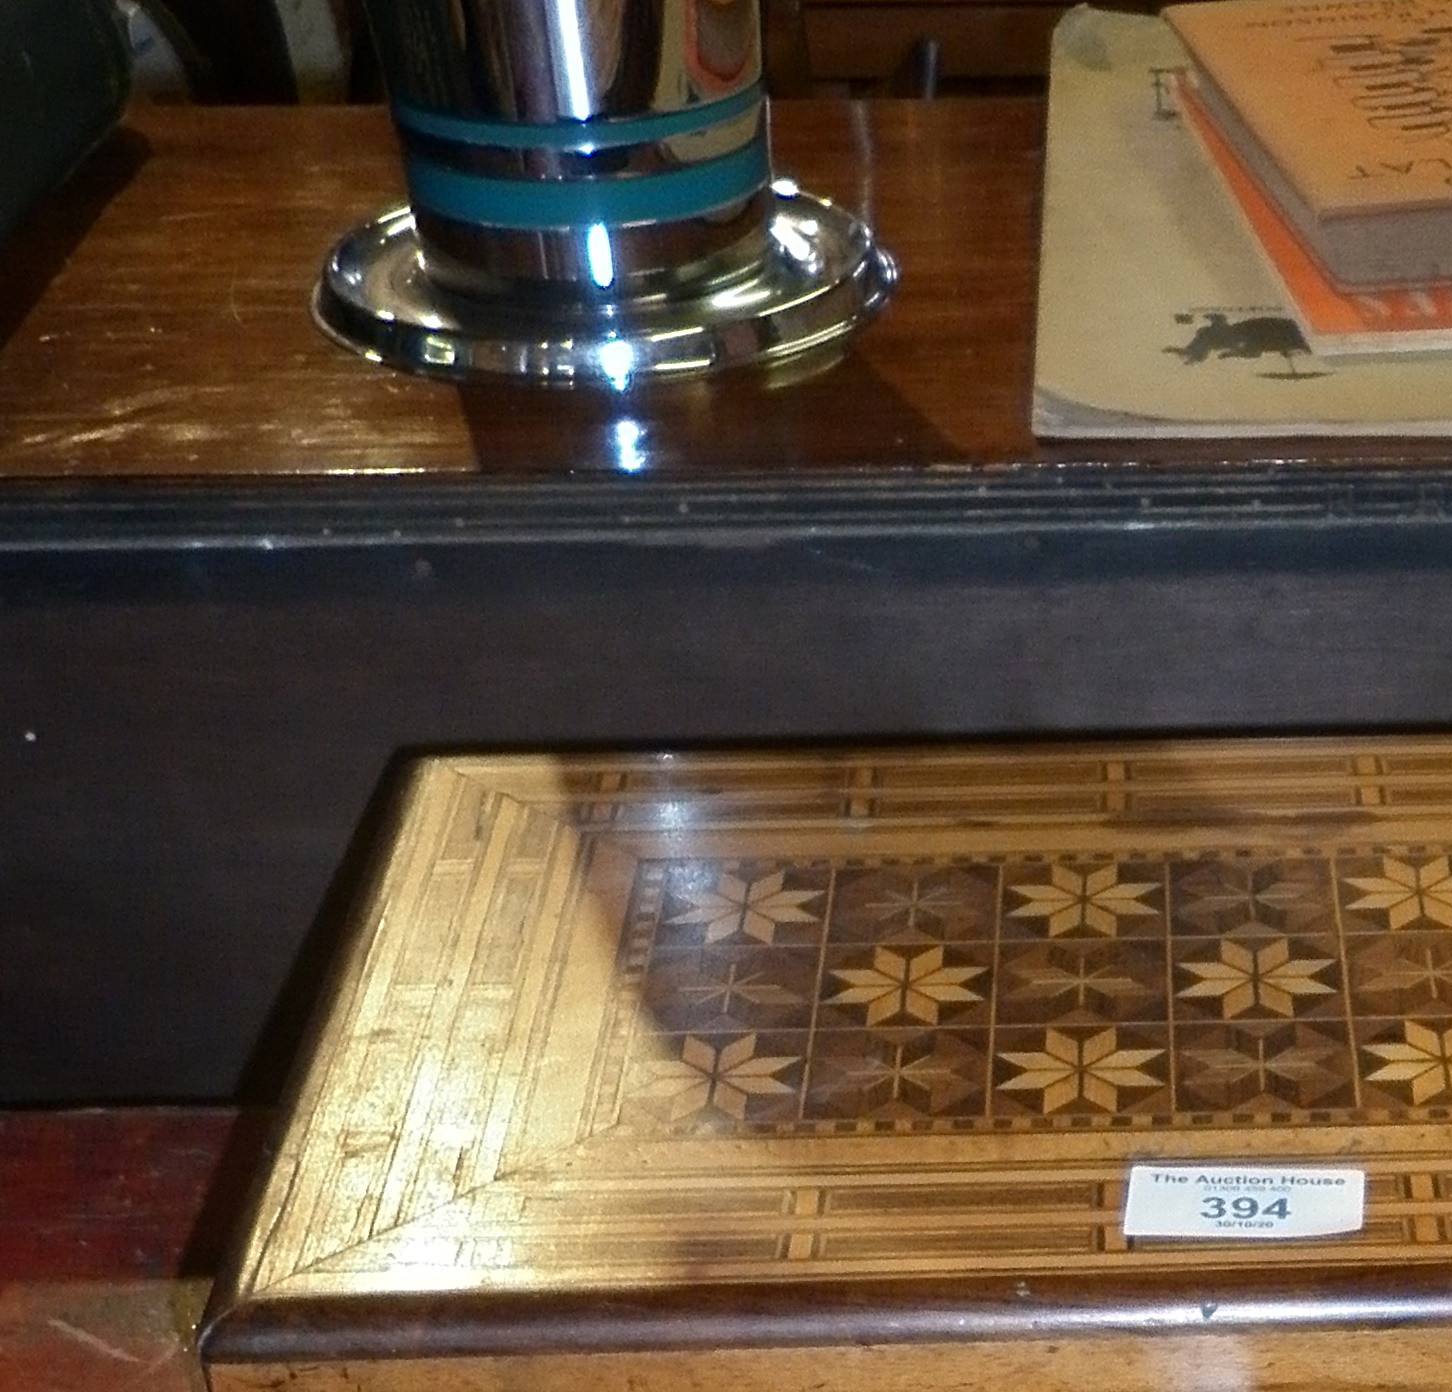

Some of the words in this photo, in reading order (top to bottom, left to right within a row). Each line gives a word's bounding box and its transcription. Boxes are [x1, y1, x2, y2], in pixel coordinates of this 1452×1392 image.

[1151, 1172, 1189, 1184] The
[1195, 1173, 1274, 1186] Auction
[1280, 1174, 1347, 1187] House
[1200, 1196, 1292, 1220] 394
[1214, 1219, 1275, 1230] 30/10/20
